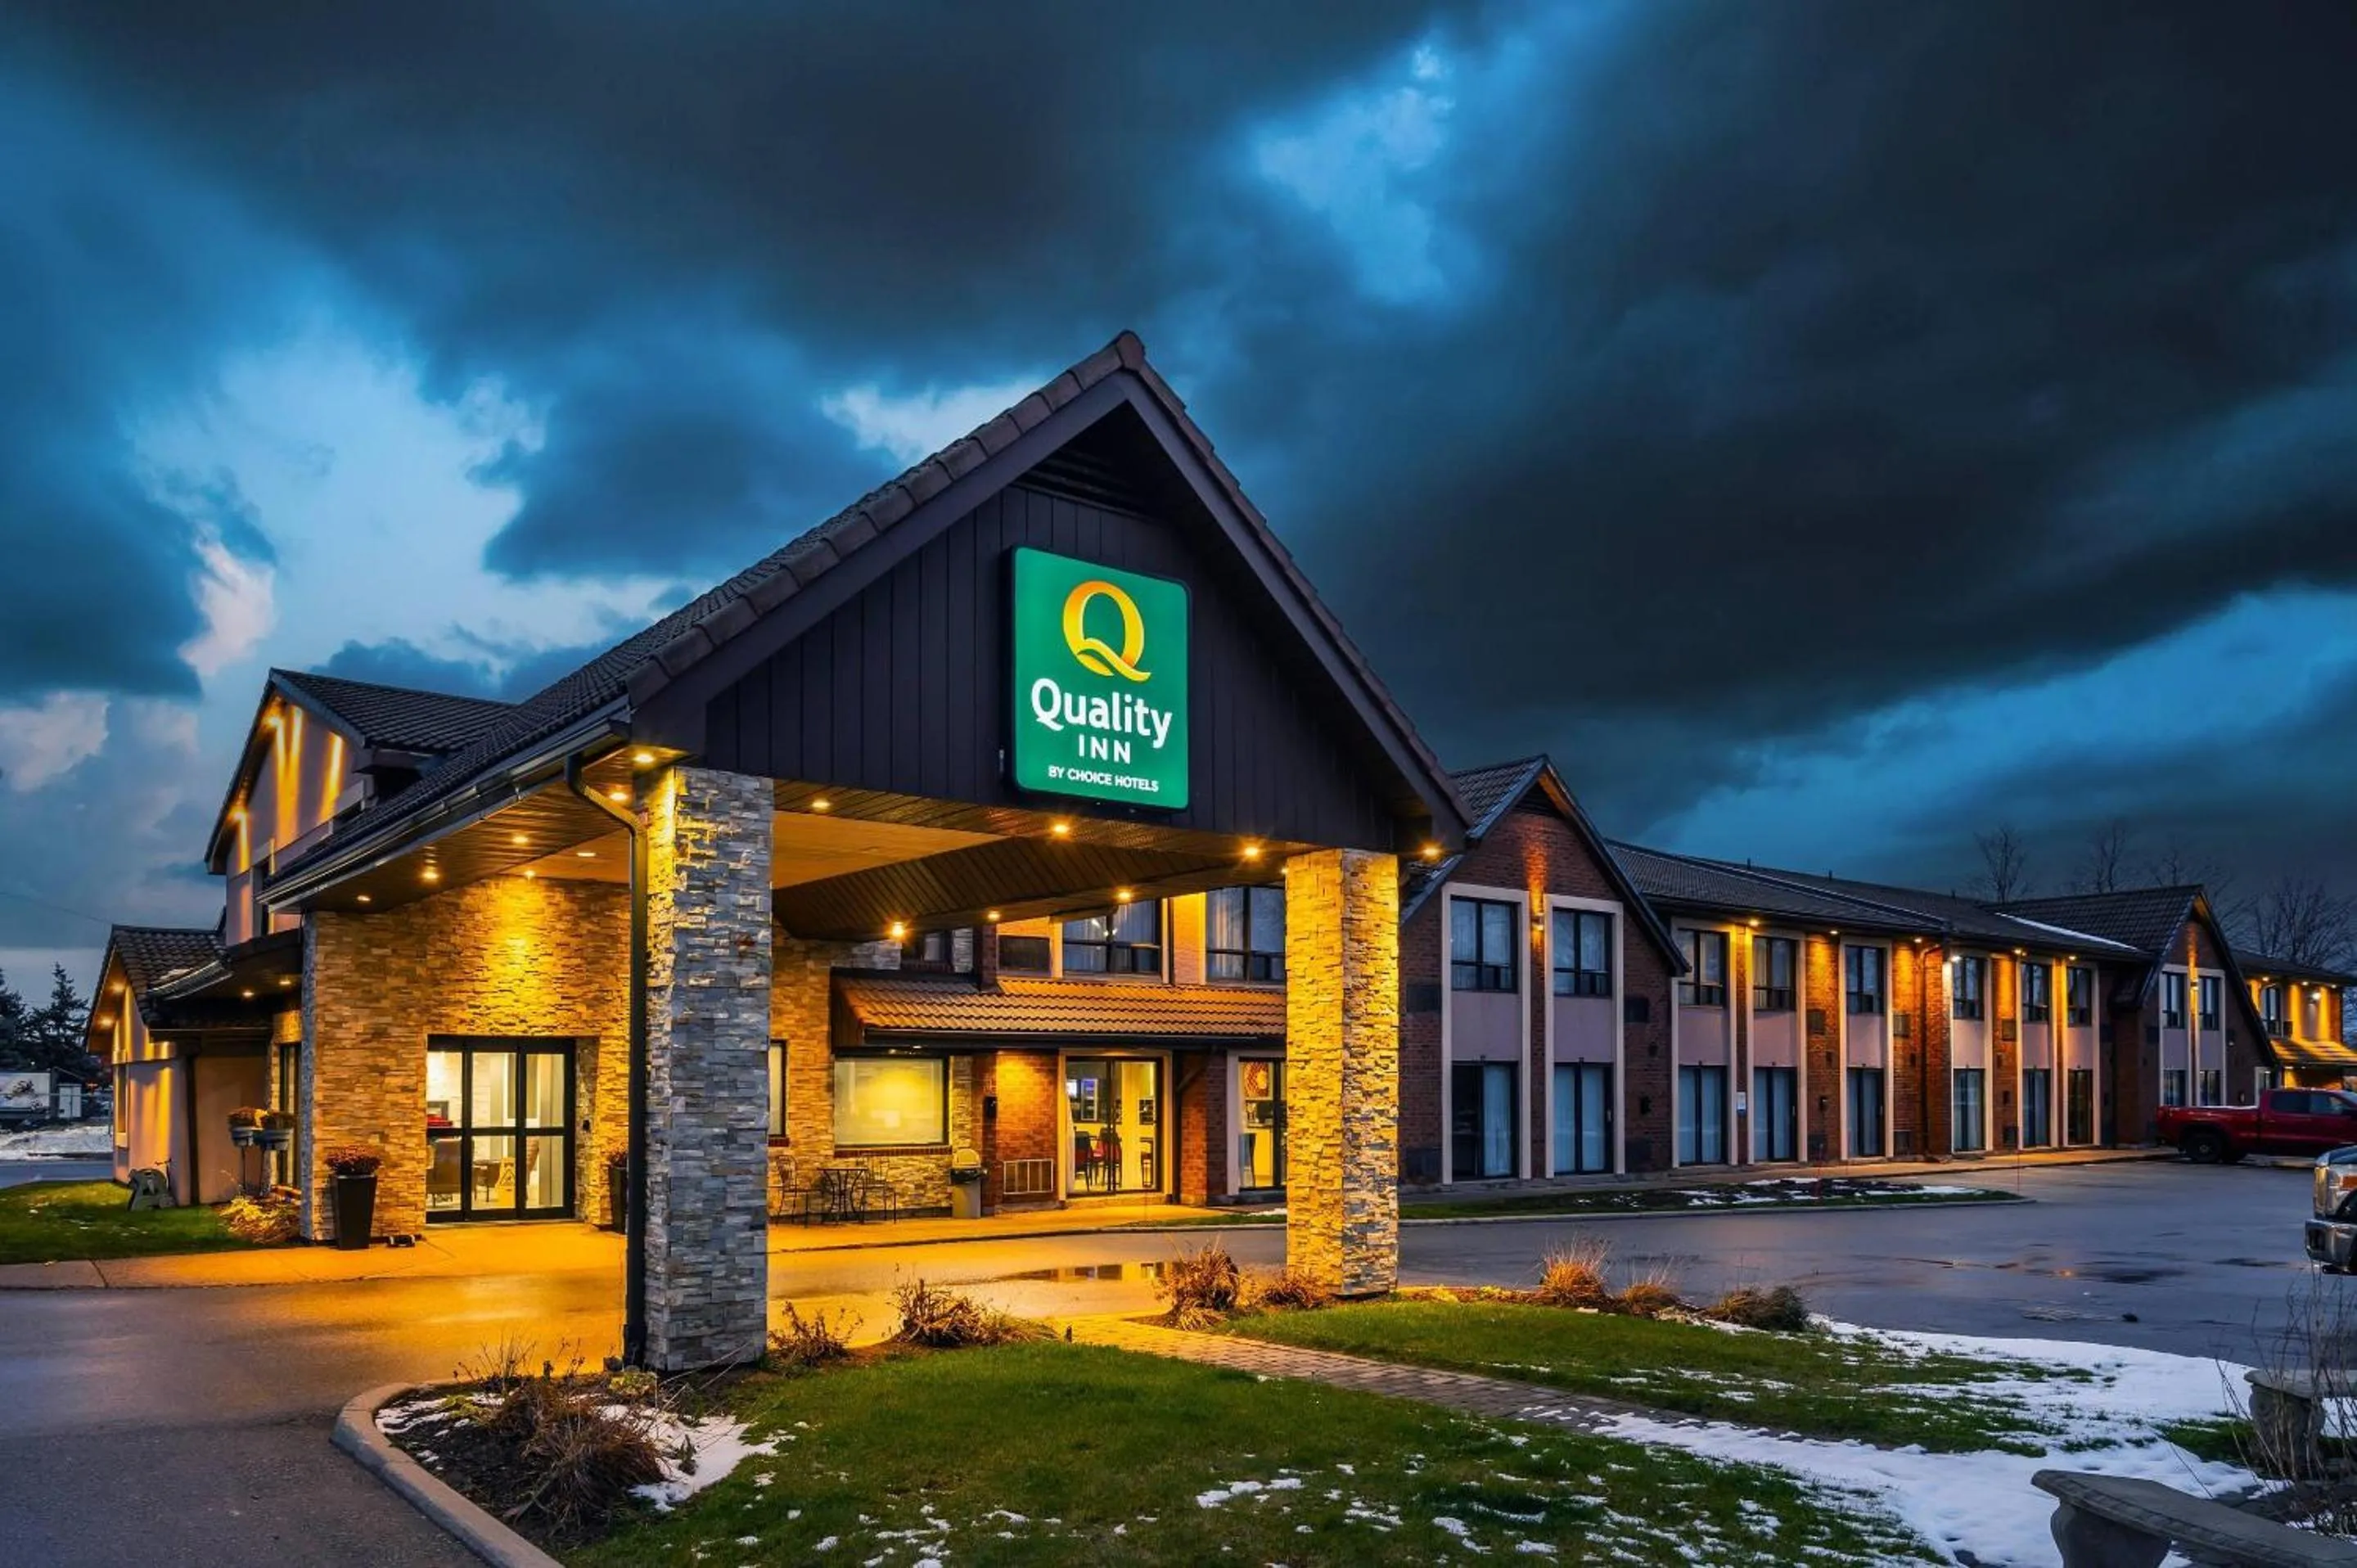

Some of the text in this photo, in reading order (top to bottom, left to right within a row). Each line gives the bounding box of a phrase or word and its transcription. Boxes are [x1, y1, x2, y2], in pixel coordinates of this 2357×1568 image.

[1063, 580, 1151, 682] Q
[1031, 678, 1173, 749] Quality
[1079, 733, 1131, 764] INN
[1048, 764, 1159, 792] BY CHOICE HOTELS
